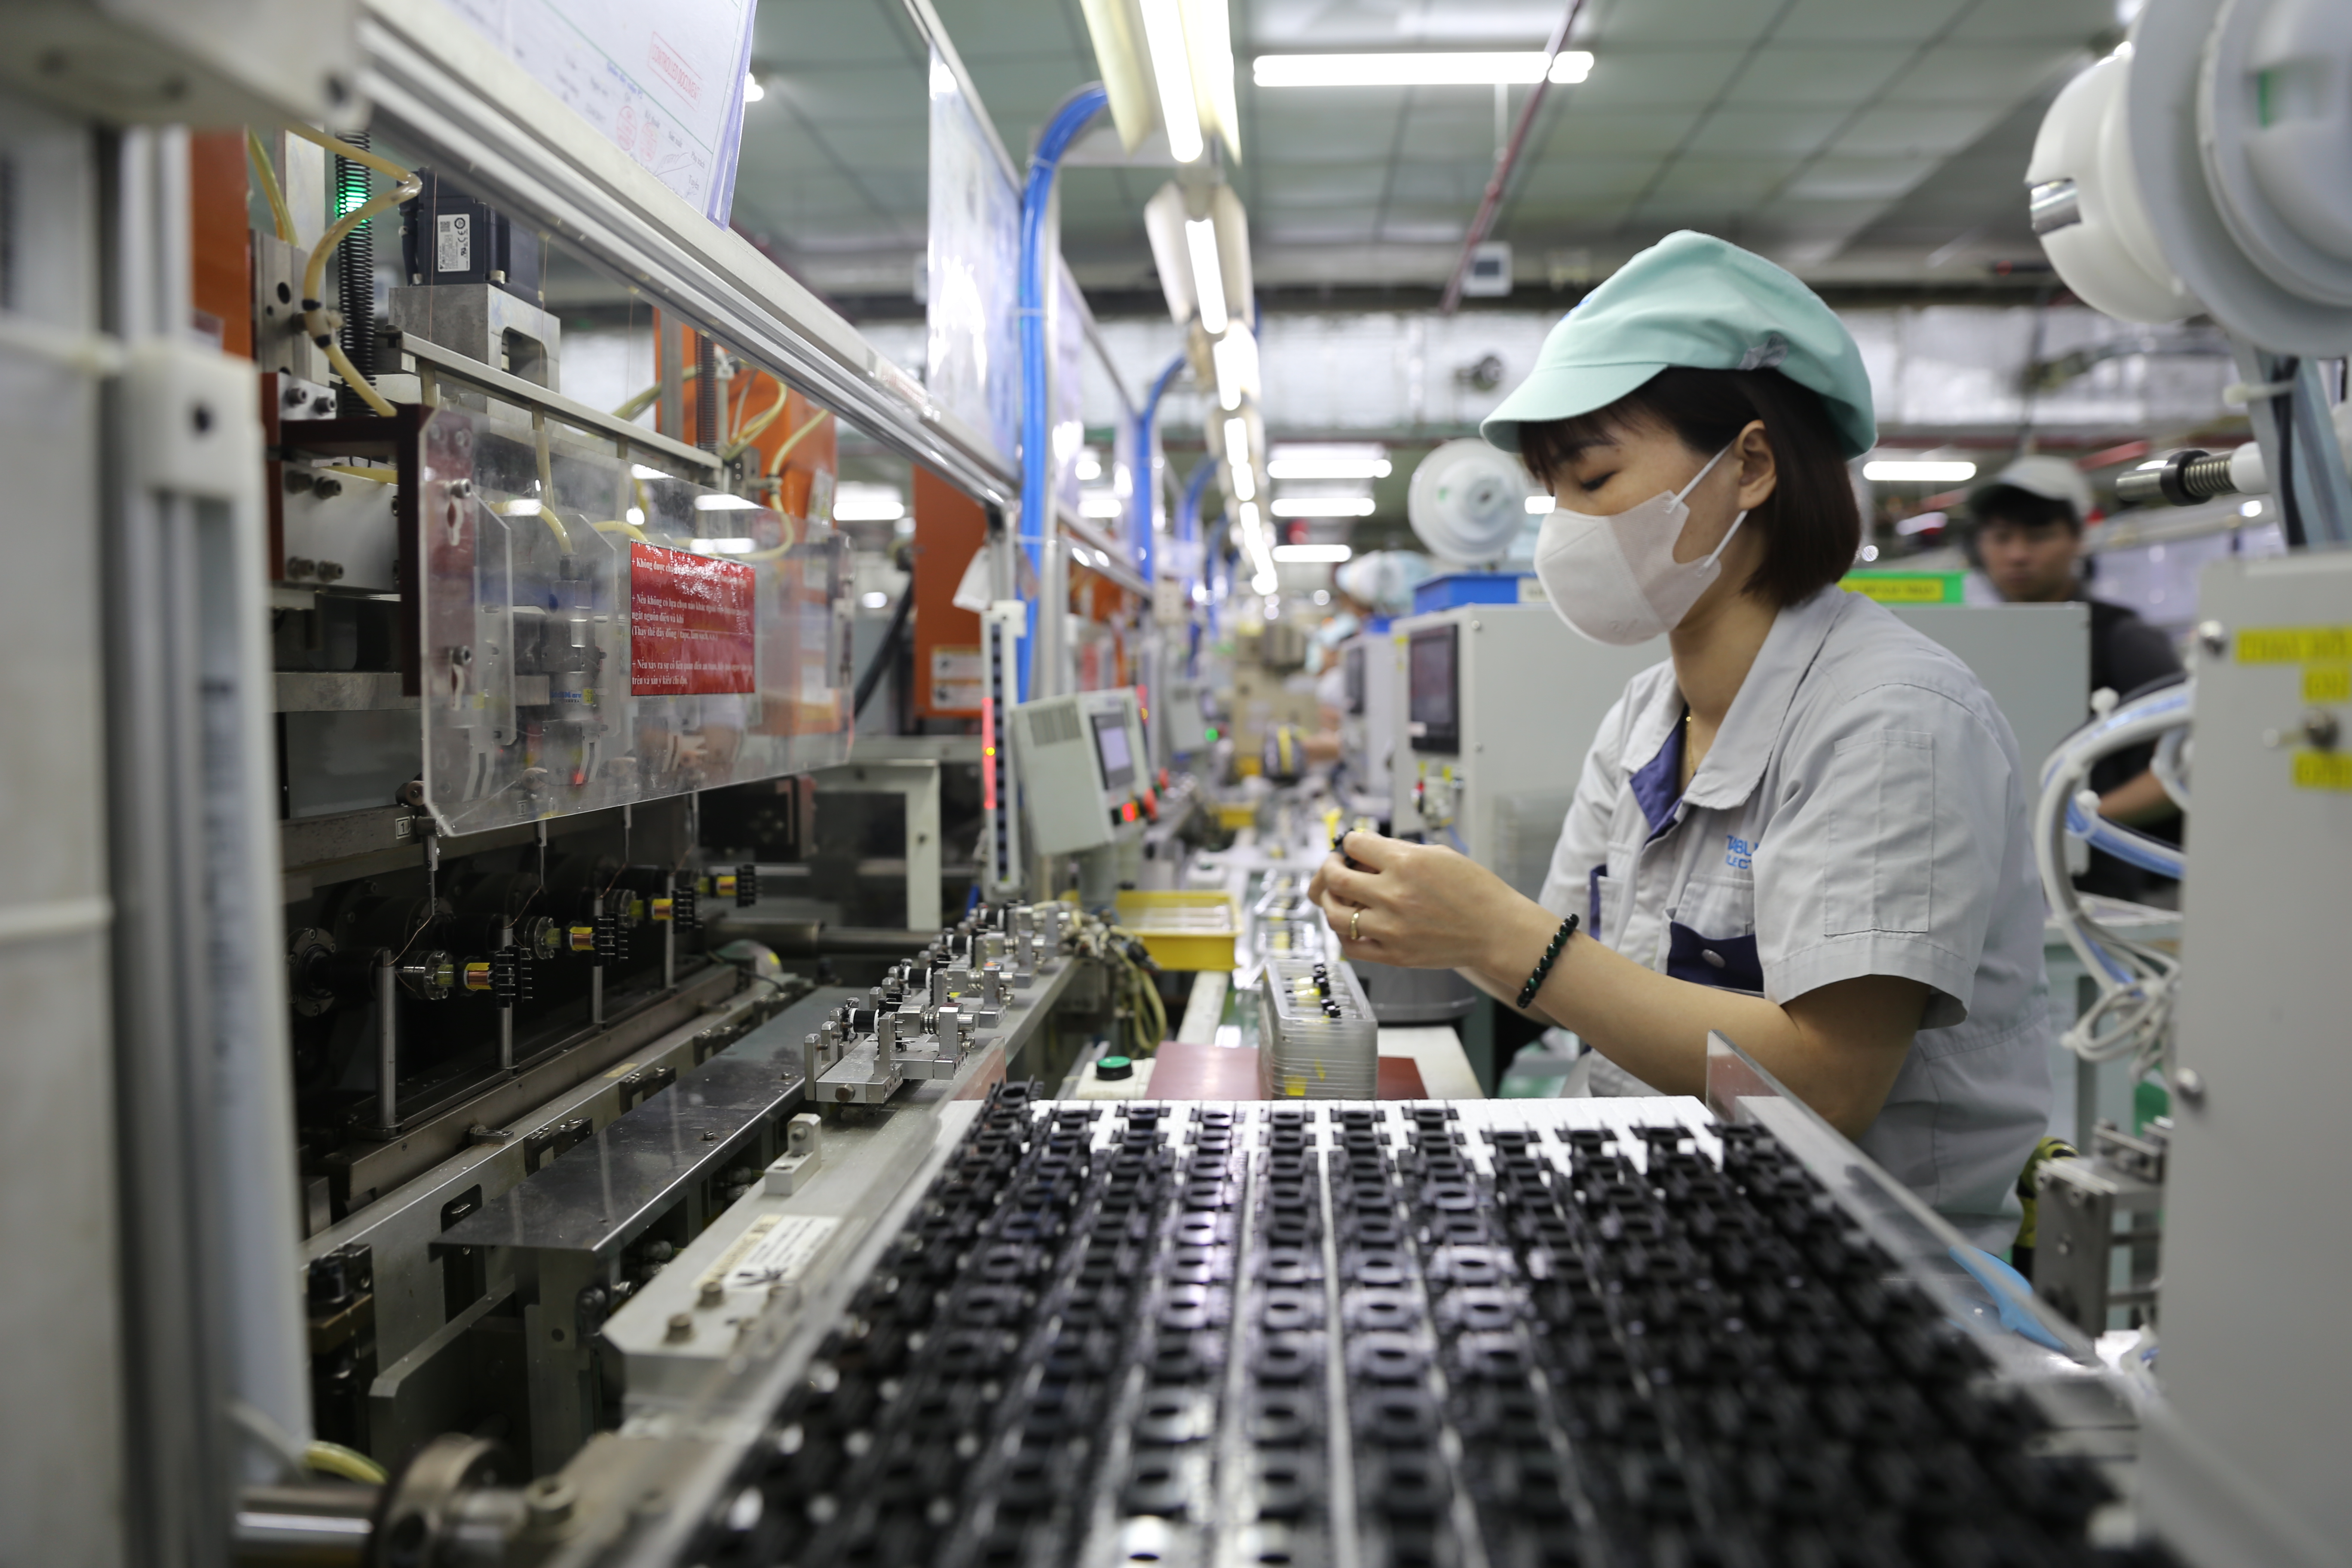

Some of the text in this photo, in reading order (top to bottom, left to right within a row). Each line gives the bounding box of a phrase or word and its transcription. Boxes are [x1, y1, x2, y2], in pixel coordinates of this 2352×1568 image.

[637, 557, 653, 572] Không
[653, 560, 665, 574] được
[637, 591, 646, 604] Nếu
[647, 595, 662, 609] không
[663, 597, 668, 606] có
[631, 607, 643, 622] ngắt
[644, 609, 659, 623] nguồn
[637, 656, 647, 669] Nếu
[632, 675, 643, 685] trên
[643, 675, 650, 685] và
[521, 804, 525, 813] 2
[401, 822, 405, 833] 1
